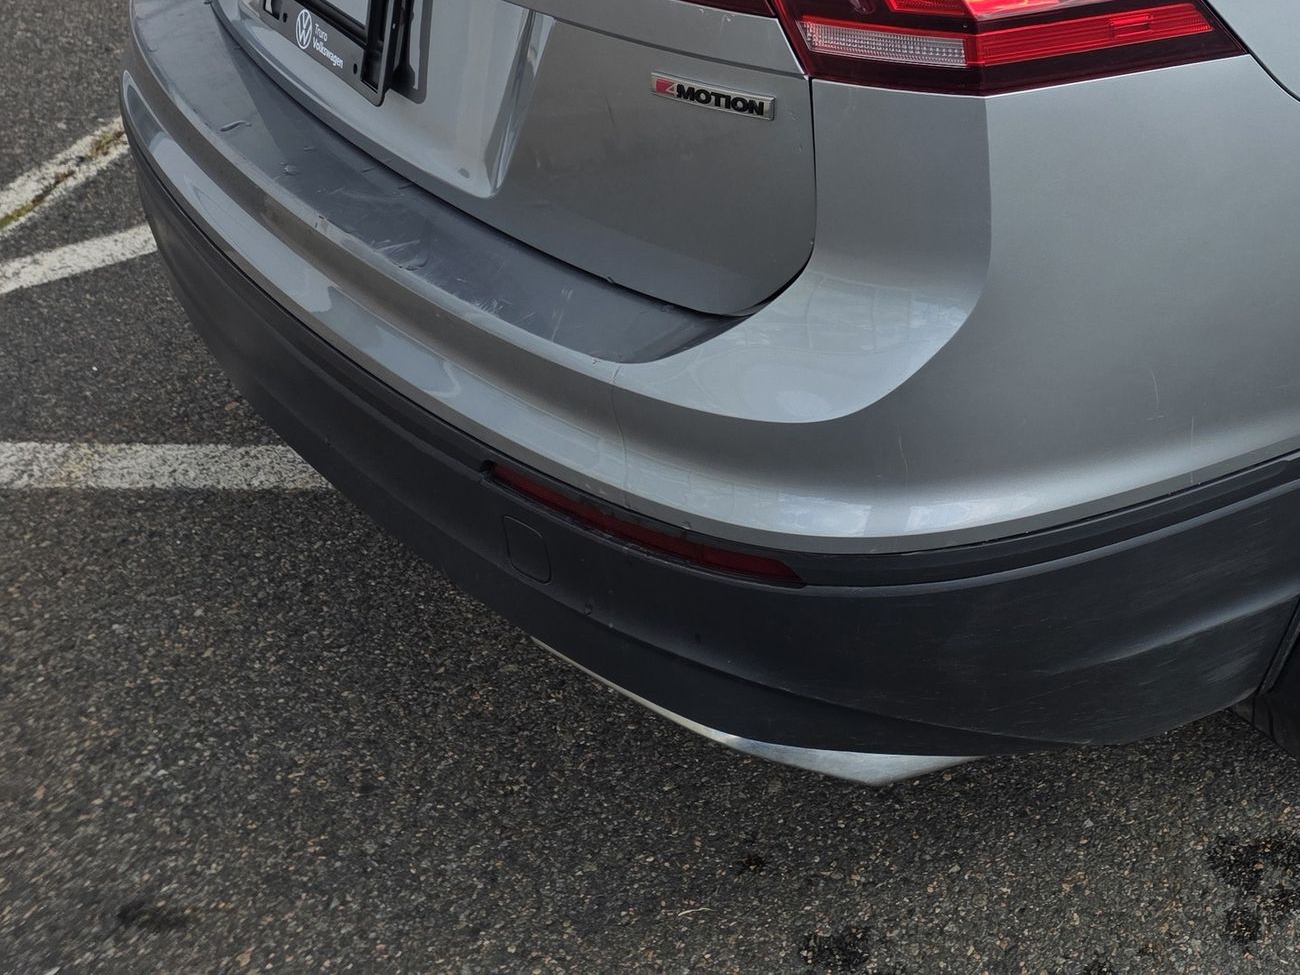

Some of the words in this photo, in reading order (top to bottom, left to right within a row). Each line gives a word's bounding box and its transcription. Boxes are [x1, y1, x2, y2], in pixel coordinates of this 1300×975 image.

[314, 23, 328, 42] Truro
[312, 36, 344, 69] Volkswagen
[655, 78, 764, 116] 4MOTION
